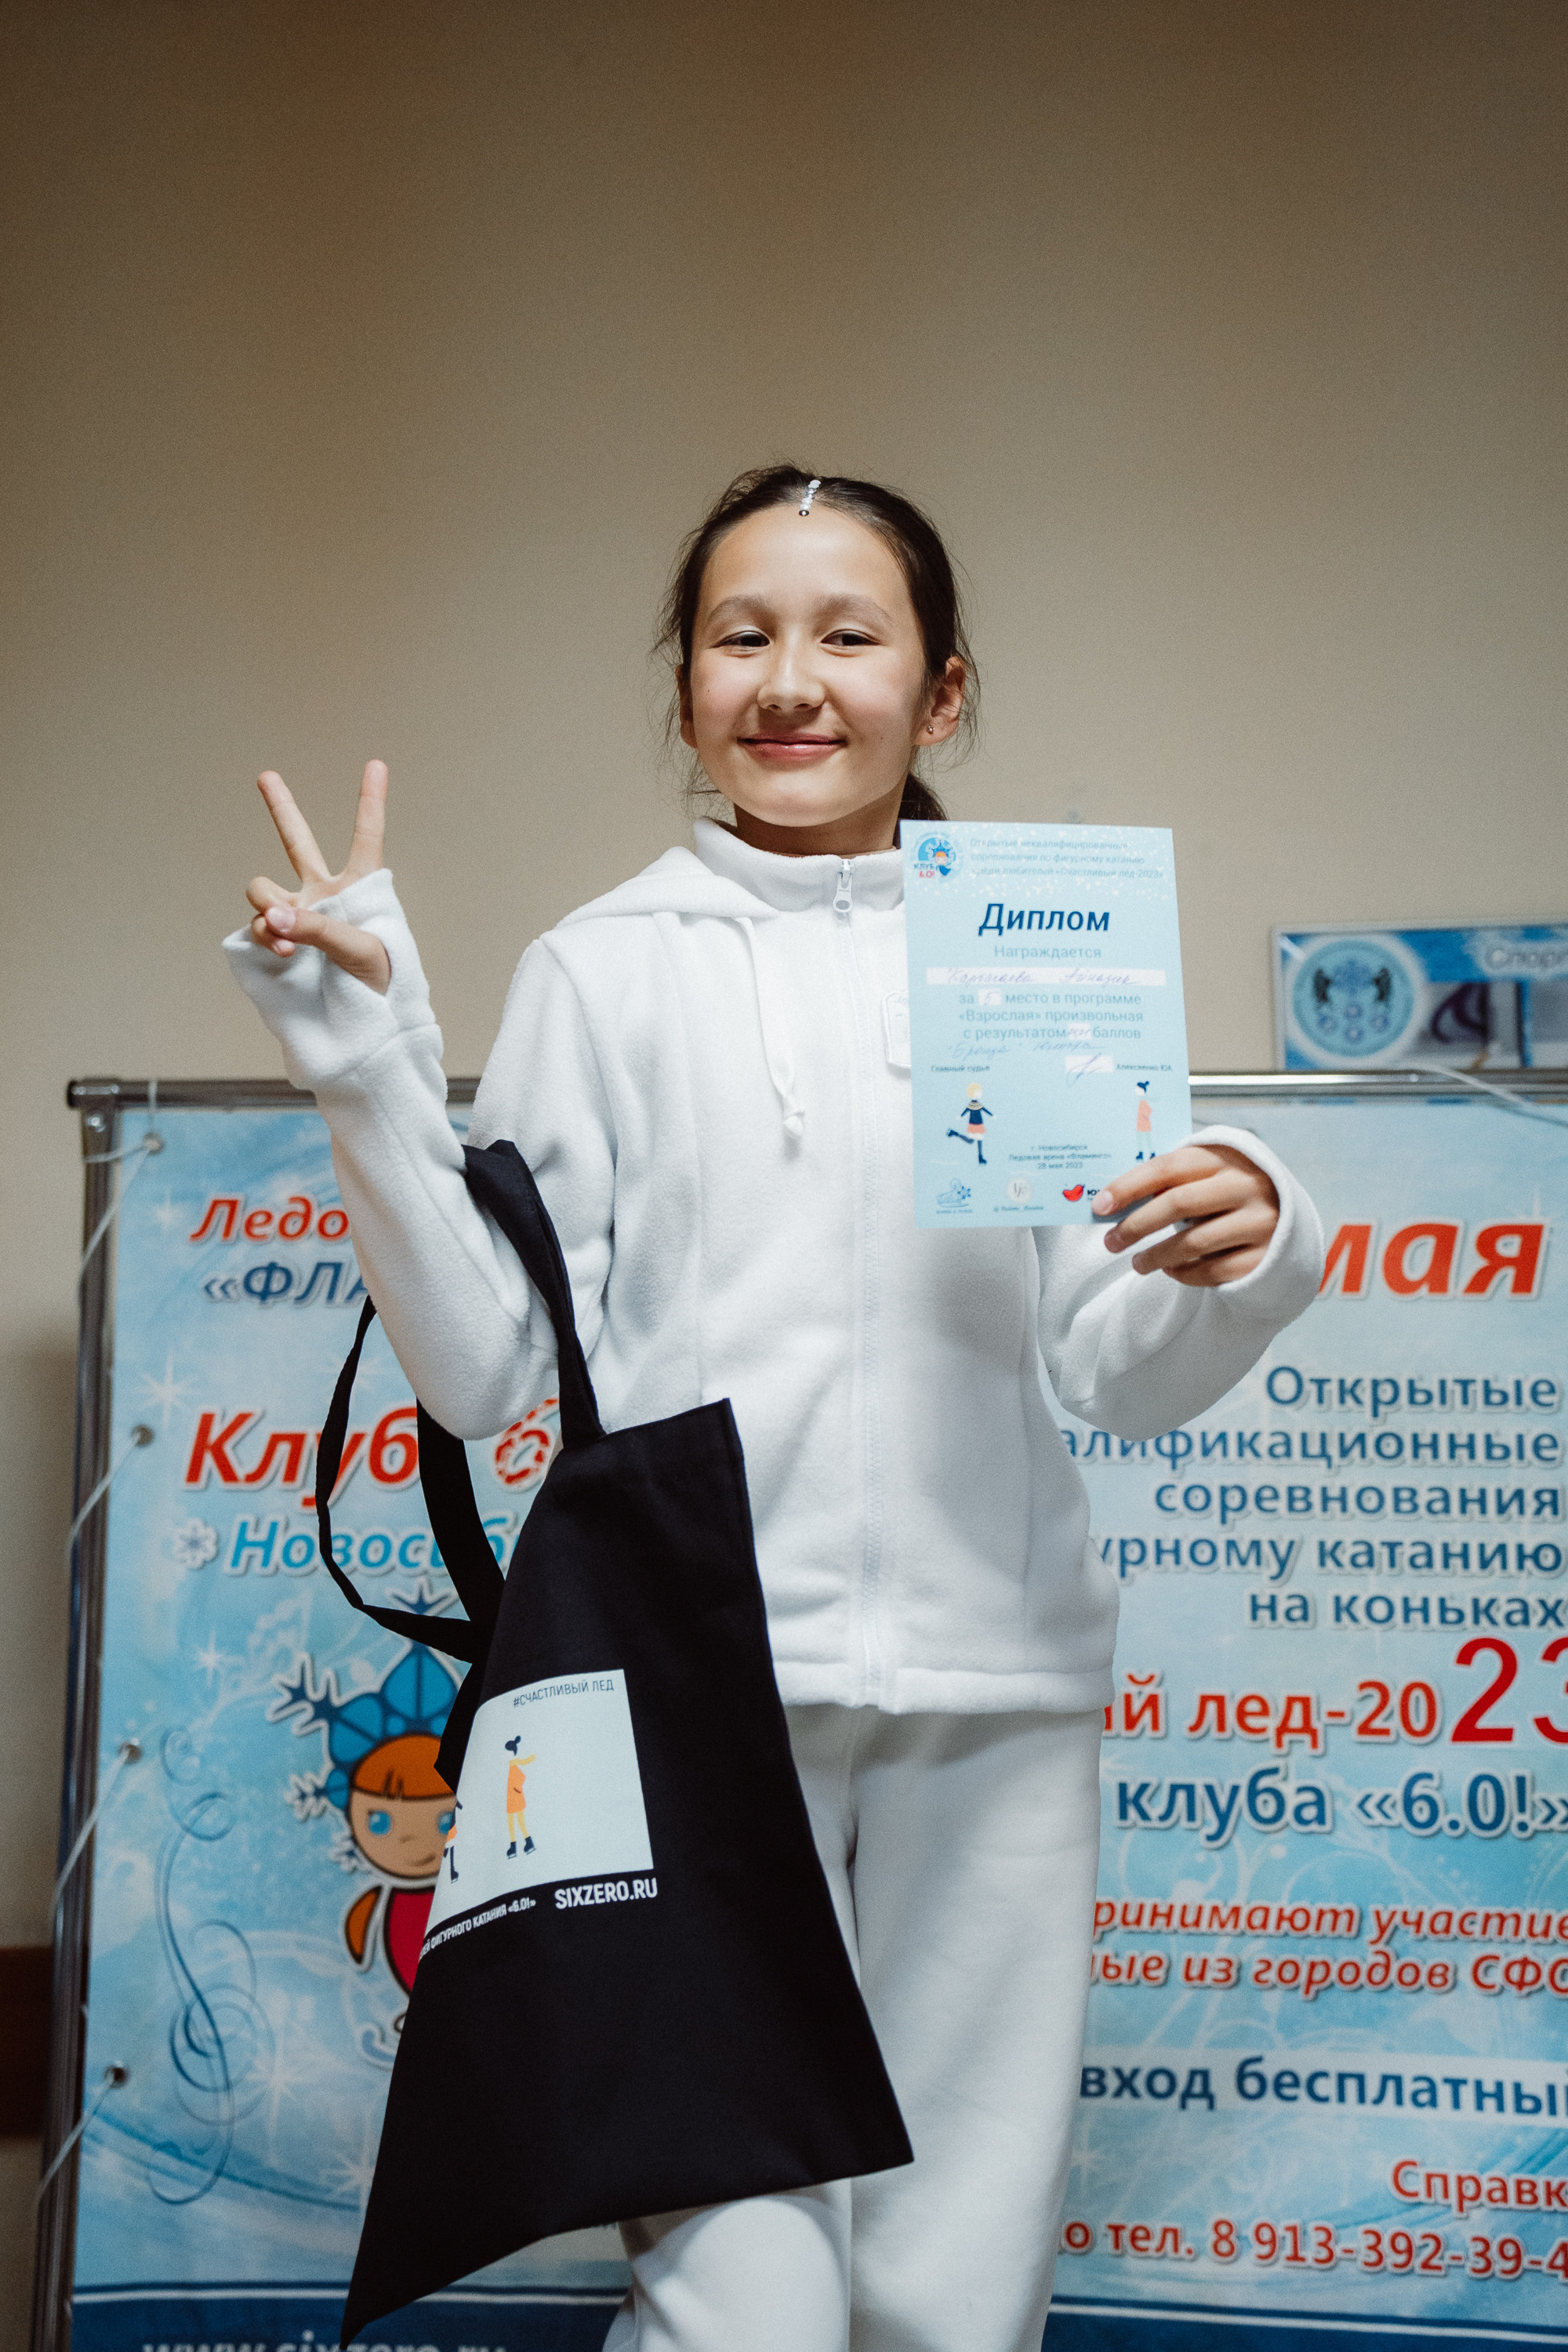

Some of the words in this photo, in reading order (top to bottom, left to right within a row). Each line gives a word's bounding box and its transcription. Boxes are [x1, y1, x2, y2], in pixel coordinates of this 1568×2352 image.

[971, 852, 1038, 863] соревнования
[1053, 853, 1104, 864] фигурному
[1105, 856, 1145, 865] катанию
[1002, 866, 1054, 876] любителей
[978, 902, 1110, 936] Диплом
[993, 945, 1102, 960] Награждается
[959, 994, 975, 1004] за
[1005, 994, 1048, 1004] место
[1053, 994, 1061, 1004] в
[1064, 993, 1142, 1007] программе
[959, 1010, 1041, 1023] «Взрослая»
[1045, 1011, 1144, 1023] произвольная
[964, 1029, 971, 1039] с
[975, 1028, 1067, 1041] результатом
[1092, 1027, 1142, 1040] баллов
[190, 1196, 350, 1243] Ледо
[1266, 1366, 1558, 1418] Открытые
[1060, 1428, 1559, 1470] алификационные
[1155, 1483, 1560, 1524] соревнования
[1101, 1537, 1296, 1581] рному
[1319, 1539, 1563, 1573] катанию
[1250, 1592, 1310, 1624] на
[1334, 1594, 1567, 1628] коньках
[514, 1679, 589, 1708] #СЧАСТЛИВЫЙ
[592, 1679, 615, 1692] ЛЕД
[1116, 1766, 1328, 1842] клуба
[554, 1878, 658, 1910] SIXZERO.RU
[431, 1918, 472, 1950] ФИГУРНОГО
[473, 1903, 507, 1929] КАТАНИЯ
[508, 1896, 537, 1914] «6.0!»
[1094, 1901, 1356, 1936] ринимают
[1184, 1957, 1236, 1984] из
[1253, 1950, 1452, 1997] городов
[1080, 2065, 1216, 2111] вход
[1236, 2056, 1568, 2118] бесплатны
[1392, 2159, 1568, 2212] Справк
[1058, 2221, 1090, 2249] о
[1106, 2223, 1194, 2256] тел.
[1211, 2219, 1237, 2259] 8
[1254, 2221, 1568, 2279] 913-392-39-4
